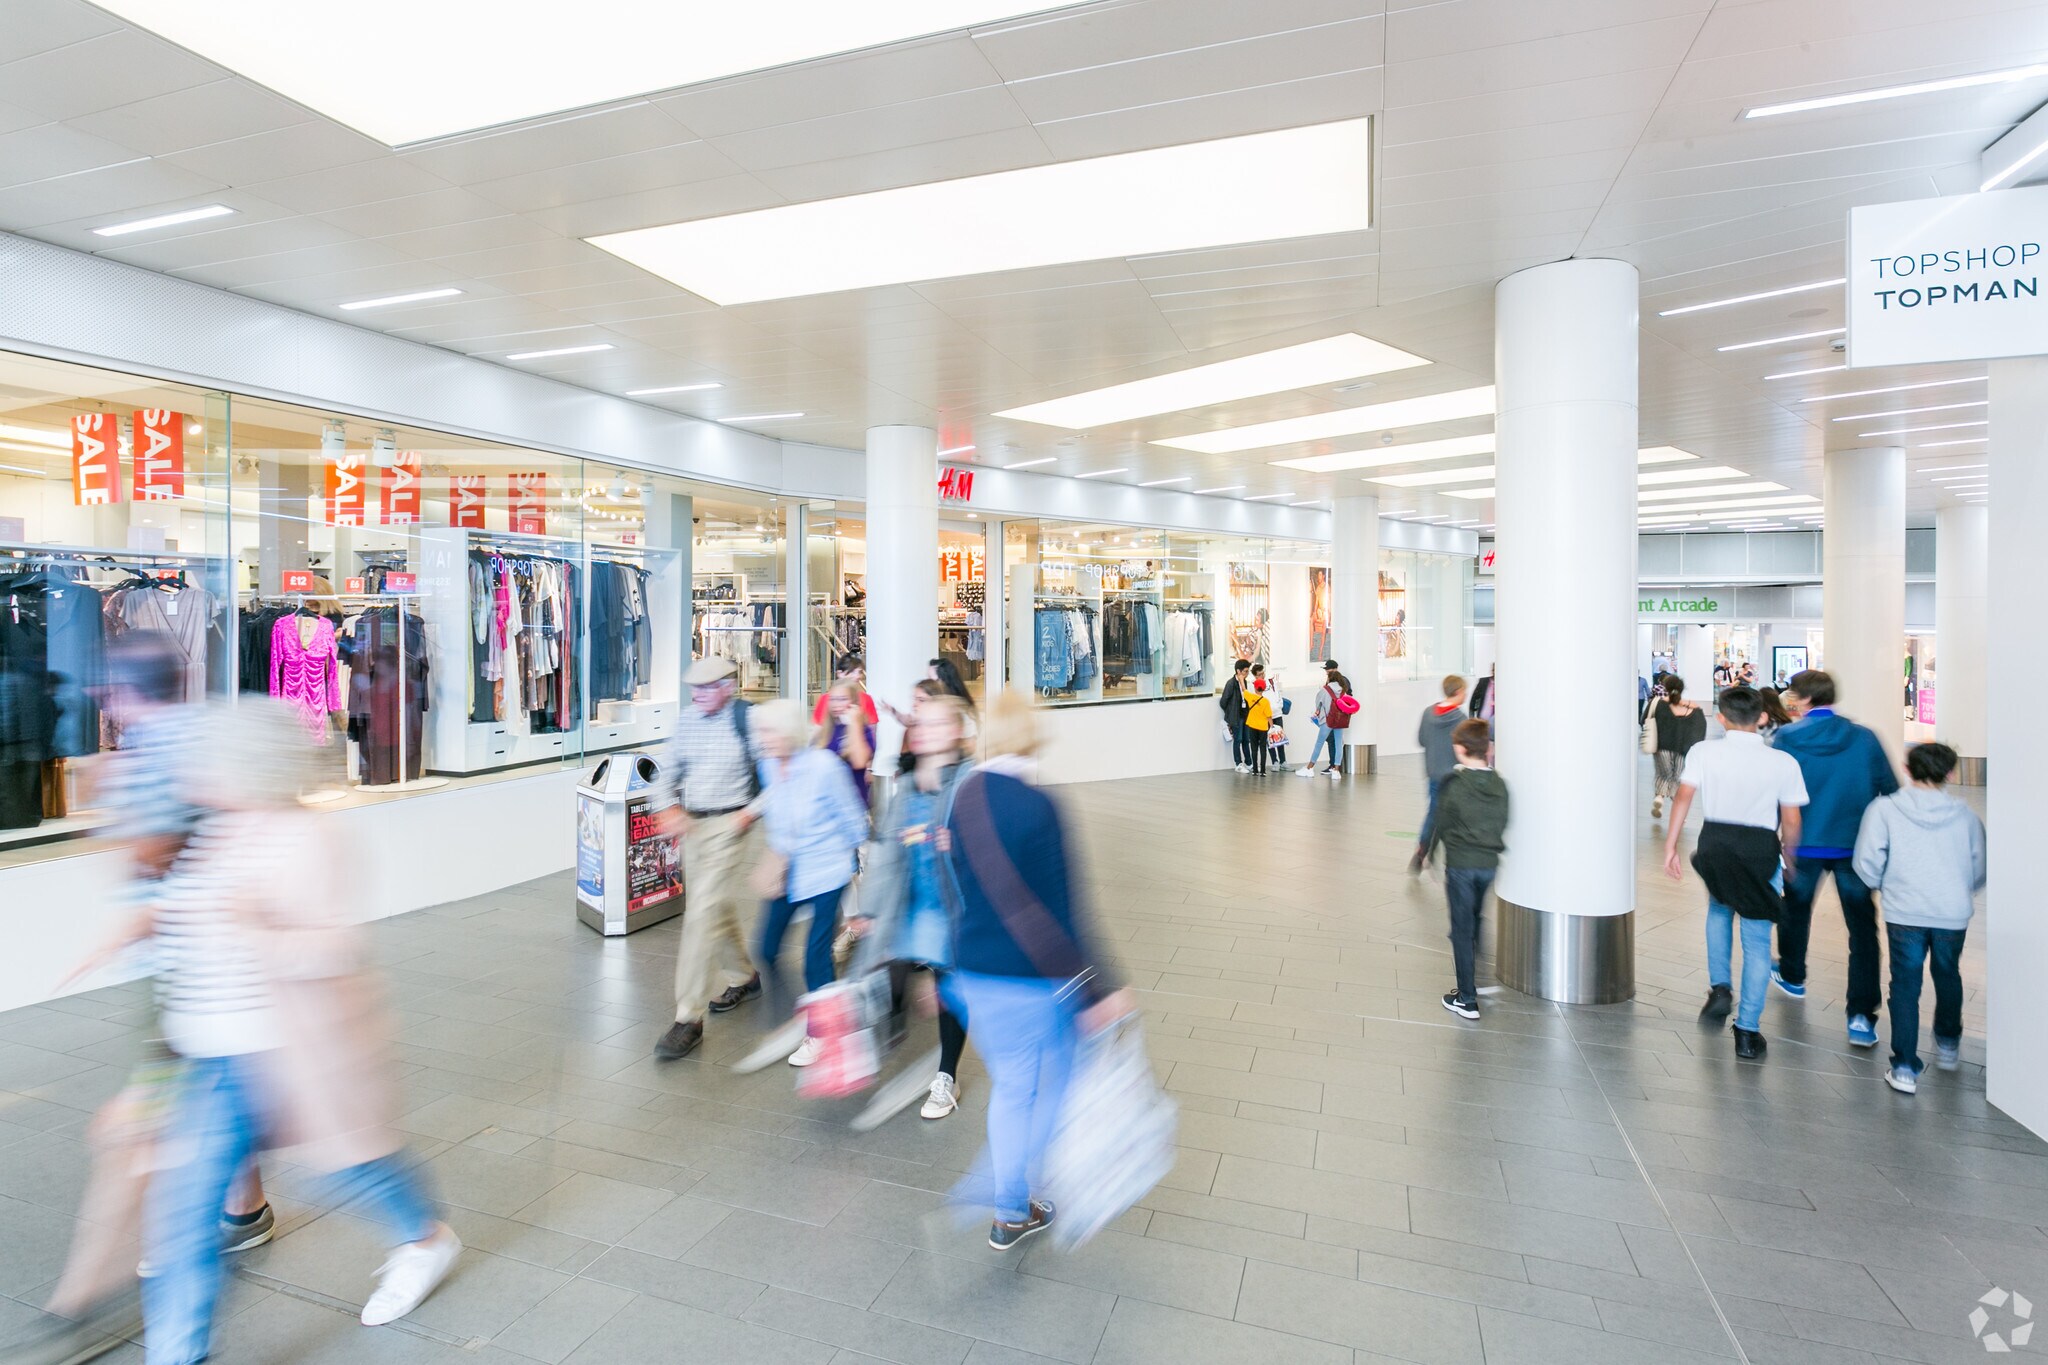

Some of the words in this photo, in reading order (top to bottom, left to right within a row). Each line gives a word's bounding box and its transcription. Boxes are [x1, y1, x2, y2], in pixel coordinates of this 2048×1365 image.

[1870, 242, 2041, 279] TOPSHOP
[1874, 277, 2037, 310] TOPMAN
[76, 413, 110, 506] SALE
[143, 408, 173, 501] SALE
[334, 454, 358, 527] SALE
[390, 452, 415, 524] SALE
[457, 476, 478, 527] SAL
[289, 575, 307, 586] £12
[350, 580, 360, 589] £6
[1637, 599, 1655, 612] nt
[1659, 597, 1718, 612] Arcade
